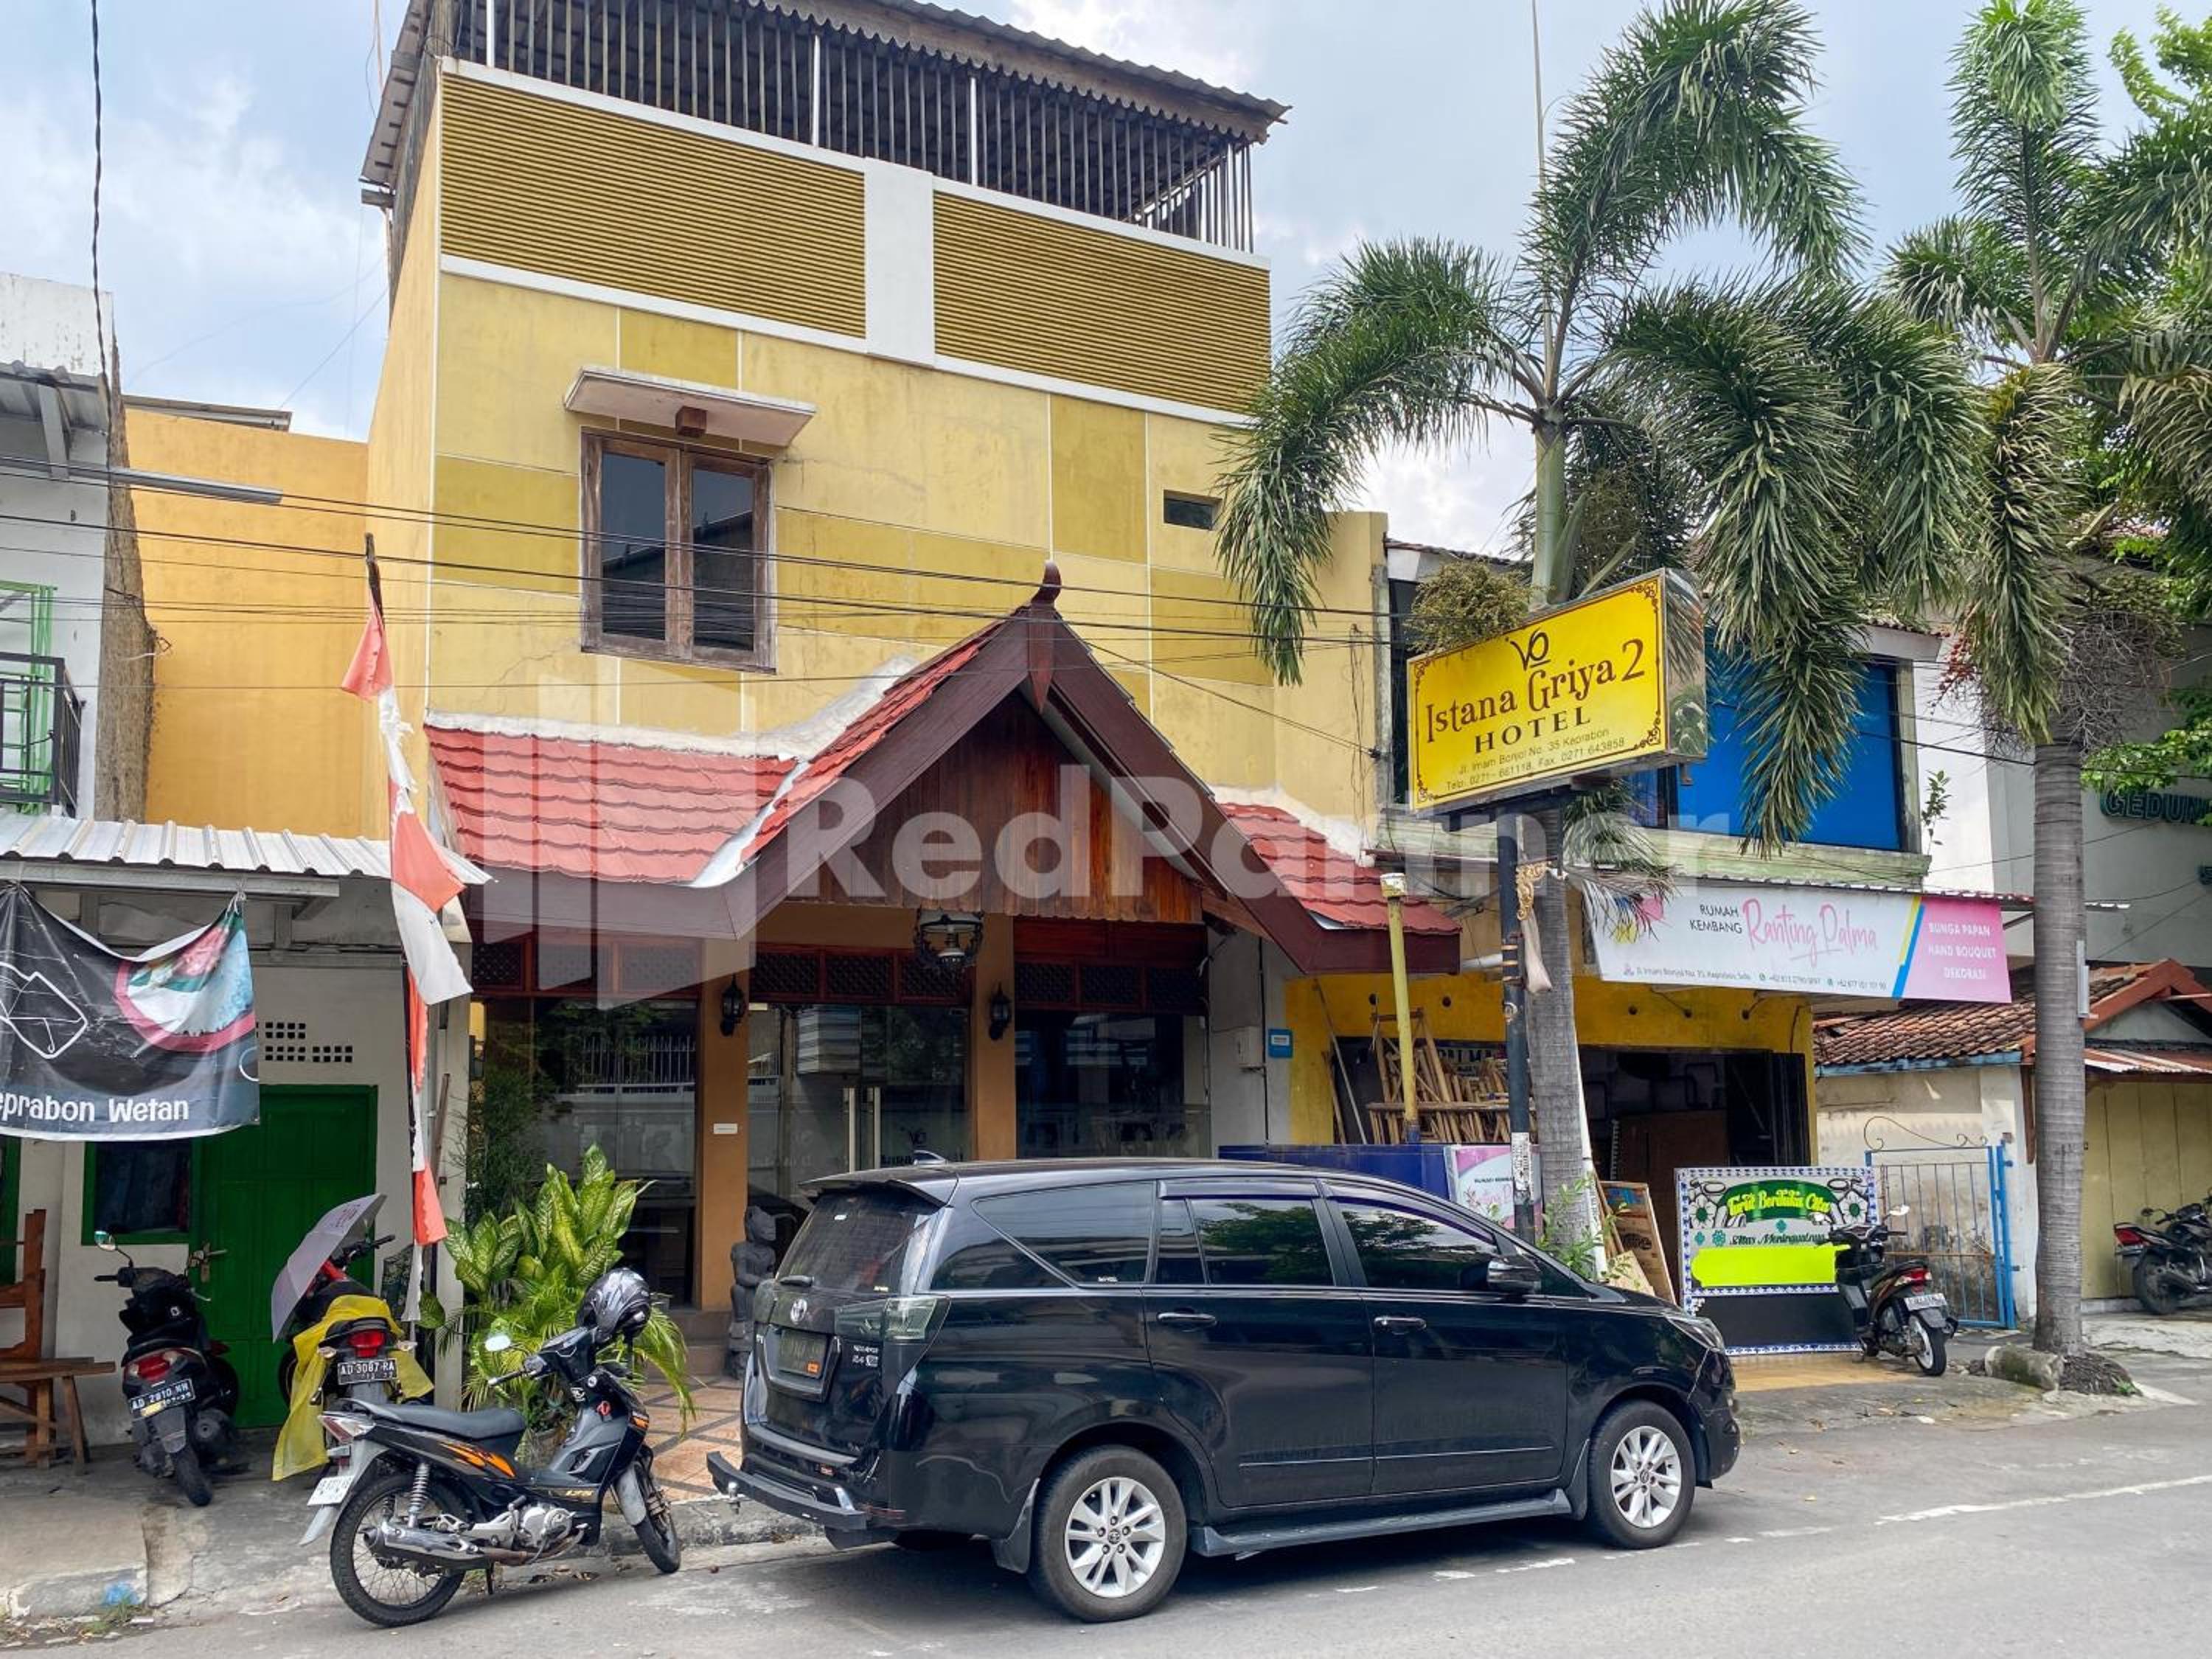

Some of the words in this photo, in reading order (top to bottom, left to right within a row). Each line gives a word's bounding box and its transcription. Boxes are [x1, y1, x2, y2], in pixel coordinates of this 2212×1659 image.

[1426, 689, 1517, 744] Istana
[1528, 658, 1616, 712] Griya
[1621, 639, 1645, 683] 2
[1475, 706, 1591, 754] HOTEL
[1472, 759, 1496, 772] Imam
[1689, 919, 1742, 934] KEMBANG
[1699, 903, 1739, 917] RUMAH
[1742, 898, 1818, 967] Ranting
[1819, 904, 1878, 956] Palma
[1961, 923, 1991, 937] PAPAN
[0, 1091, 95, 1121] prabon
[108, 1097, 189, 1123] Wetan
